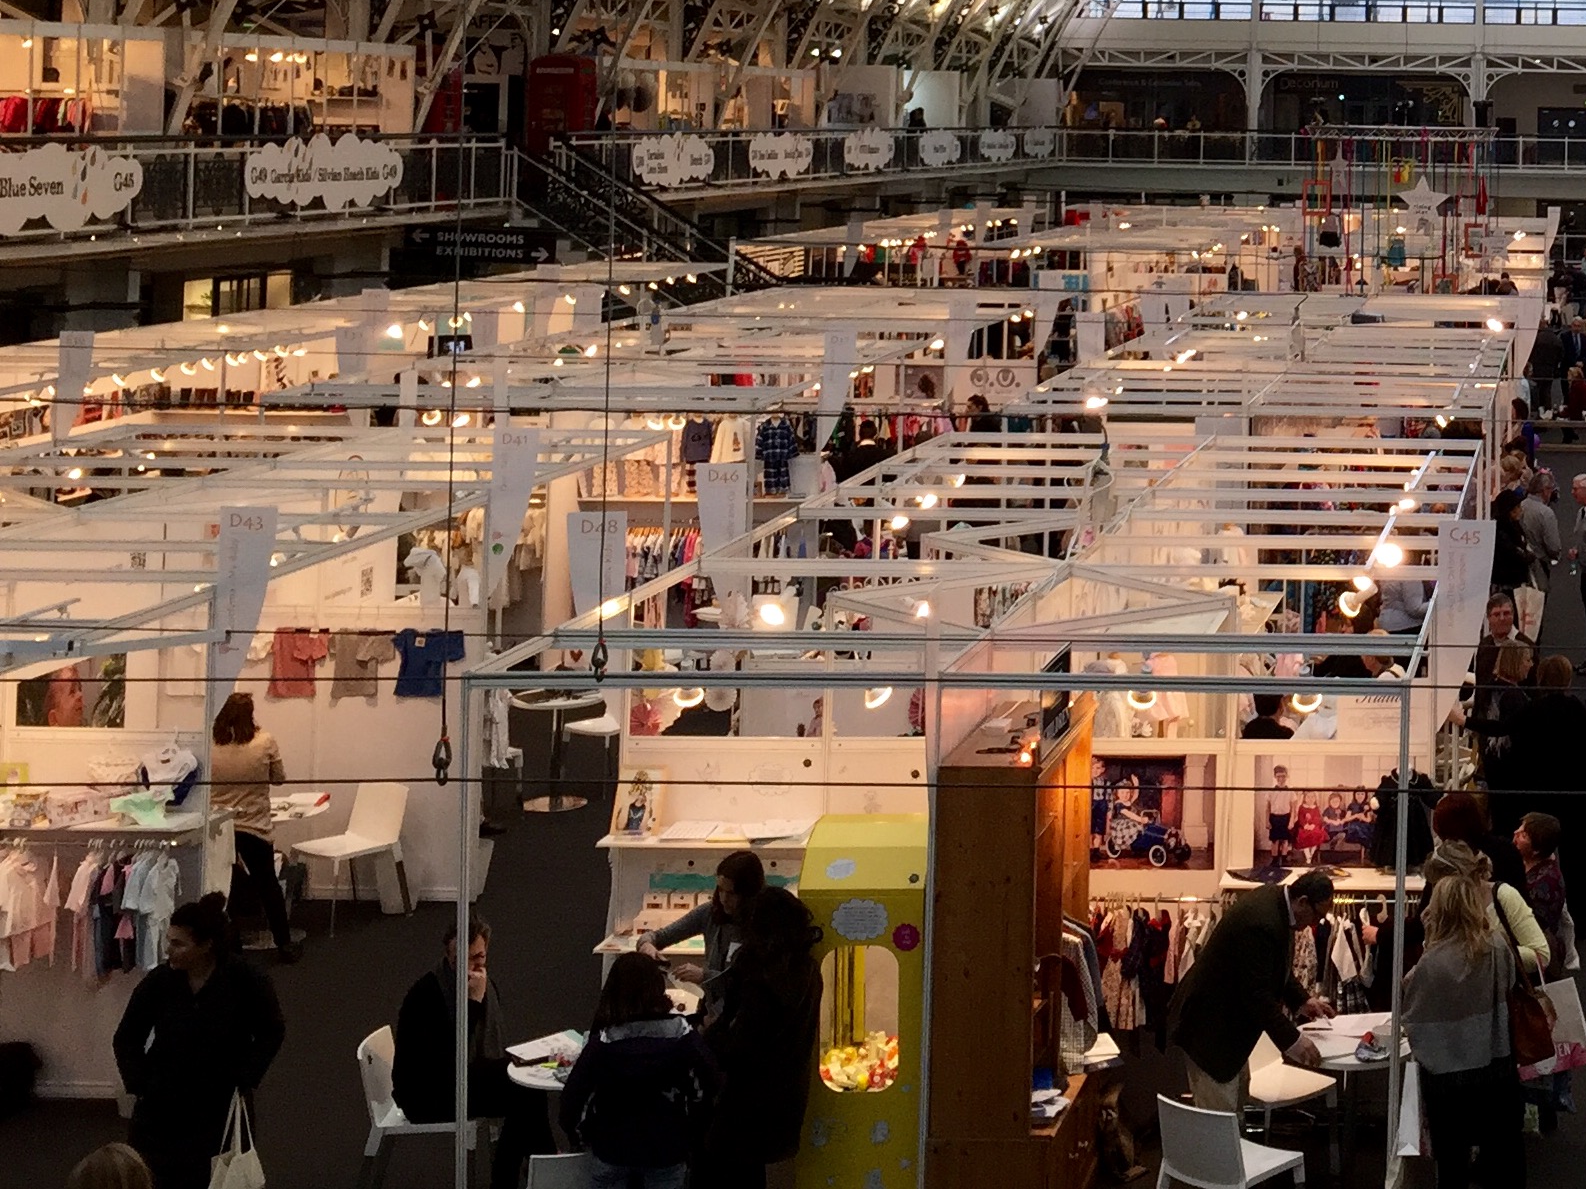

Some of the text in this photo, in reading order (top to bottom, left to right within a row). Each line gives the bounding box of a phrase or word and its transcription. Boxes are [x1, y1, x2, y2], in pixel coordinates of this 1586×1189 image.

[0, 172, 134, 199] Blue Seven G45
[436, 232, 525, 245] SHOWROOMS
[435, 245, 524, 259] EXHIBITIONS
[502, 433, 528, 446] D41
[708, 469, 740, 484] D46
[230, 513, 264, 531] D43
[581, 519, 619, 535] D48
[1449, 527, 1481, 545] C45
